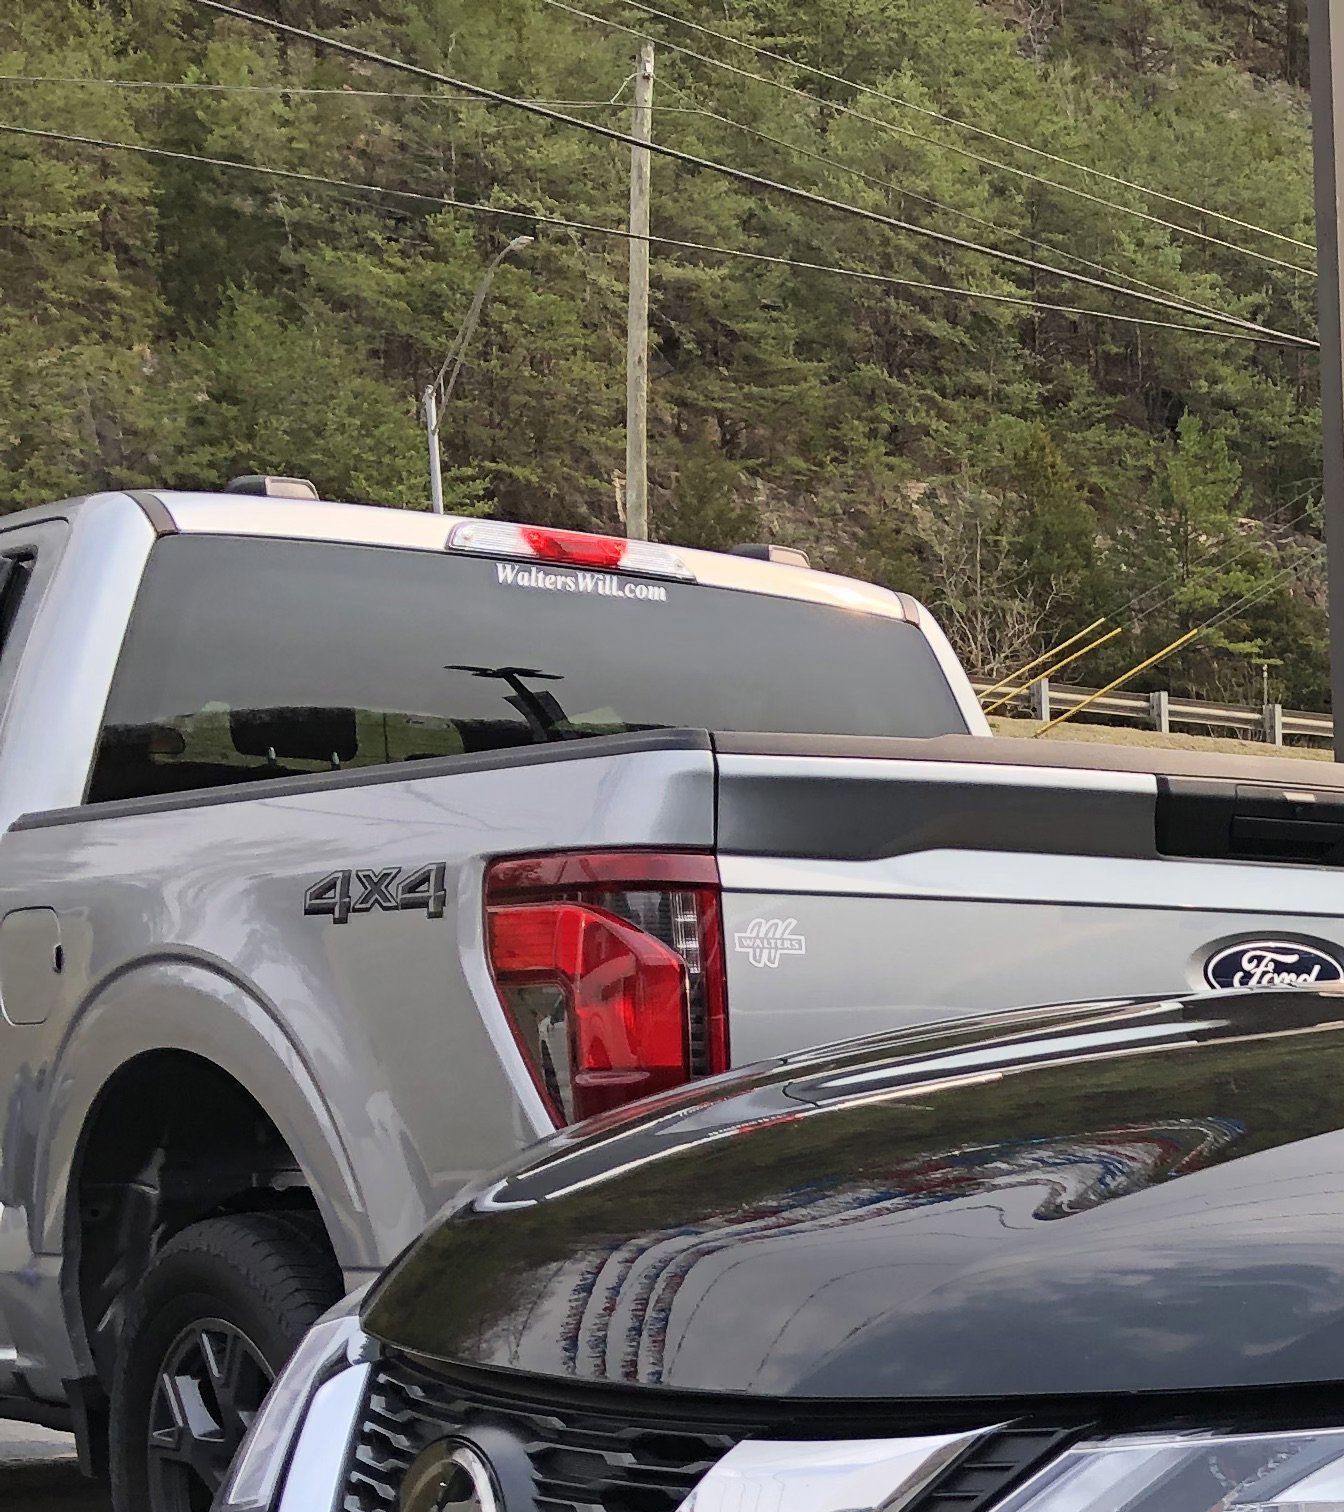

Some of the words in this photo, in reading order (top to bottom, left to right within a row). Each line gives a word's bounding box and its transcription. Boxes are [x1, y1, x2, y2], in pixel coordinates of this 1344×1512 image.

[495, 563, 667, 602] WaltersWill.com
[741, 938, 800, 949] WALTERS
[1233, 950, 1321, 987] Ford
